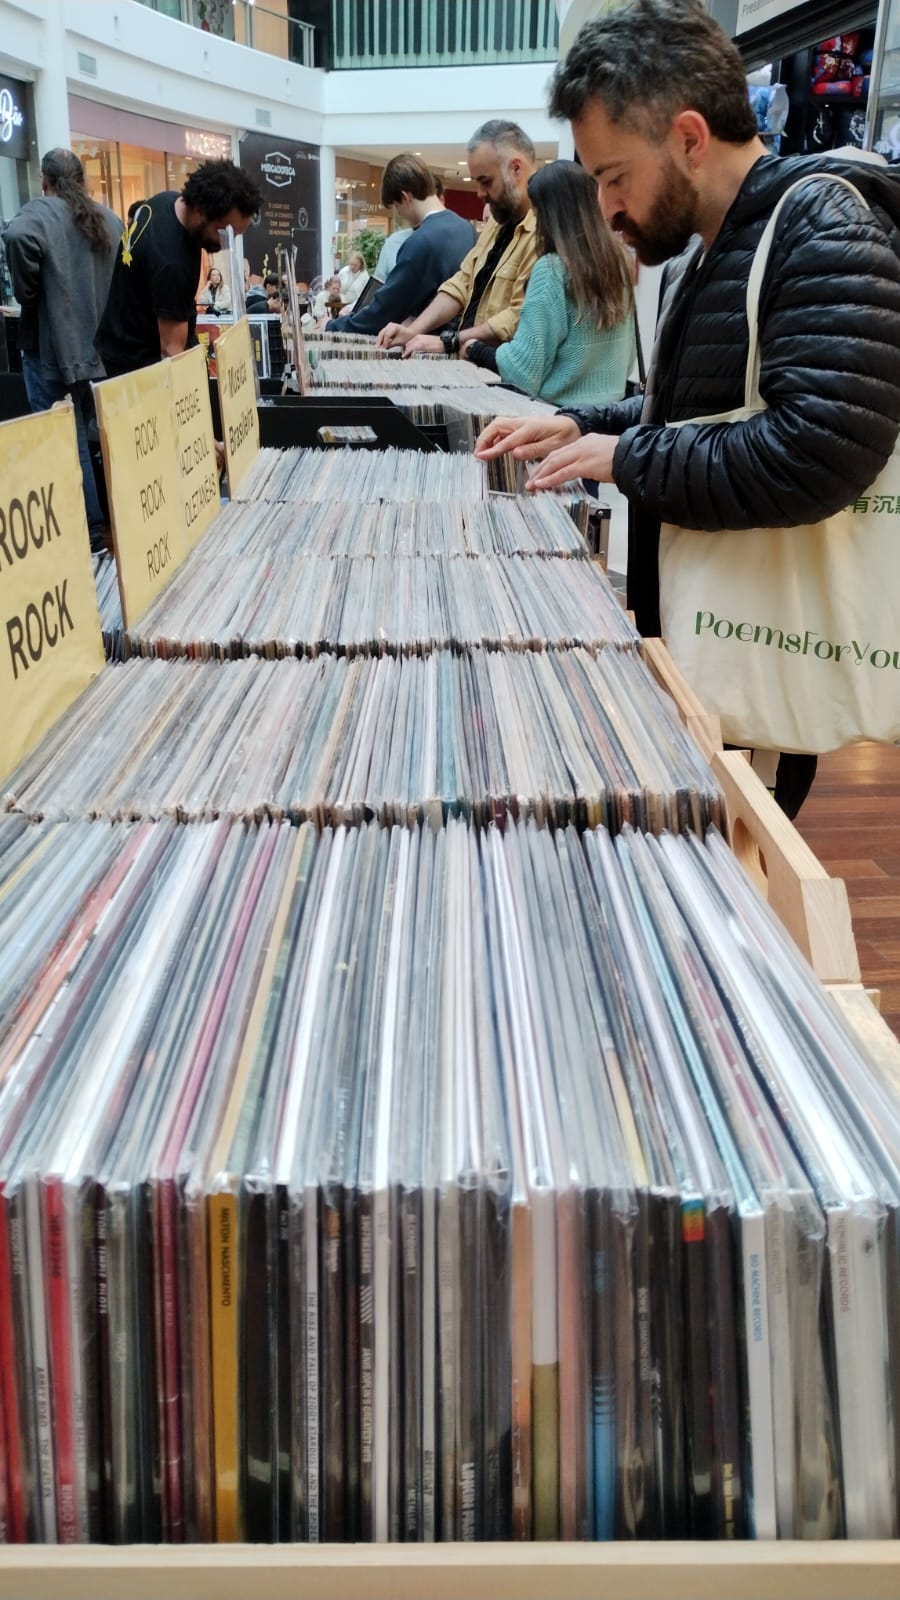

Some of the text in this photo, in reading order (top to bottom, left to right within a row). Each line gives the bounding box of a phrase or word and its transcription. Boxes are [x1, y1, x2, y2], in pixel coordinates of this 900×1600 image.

[175, 388, 201, 427] REGGAE
[134, 416, 158, 461] ROCK
[140, 475, 166, 523] ROCK
[845, 495, 900, 514] 有沉
[146, 532, 172, 582] ROCK
[6, 578, 75, 680] ROCK
[97, 1210, 108, 1315] STONE TEMPLE PILOTS
[220, 1208, 232, 1307] MILTON NASCIMENTO
[837, 1217, 851, 1313] REPUBLIC RECORDS
[751, 1270, 761, 1305] MACHINE
[753, 1307, 764, 1343] RECORDS
[308, 1358, 317, 1377] FALL
[361, 1347, 372, 1368] JANIS
[36, 1366, 47, 1397] ABBEY
[38, 1400, 49, 1427] ROAD
[61, 1484, 74, 1523] RINGO
[407, 1489, 417, 1531] METALLICA
